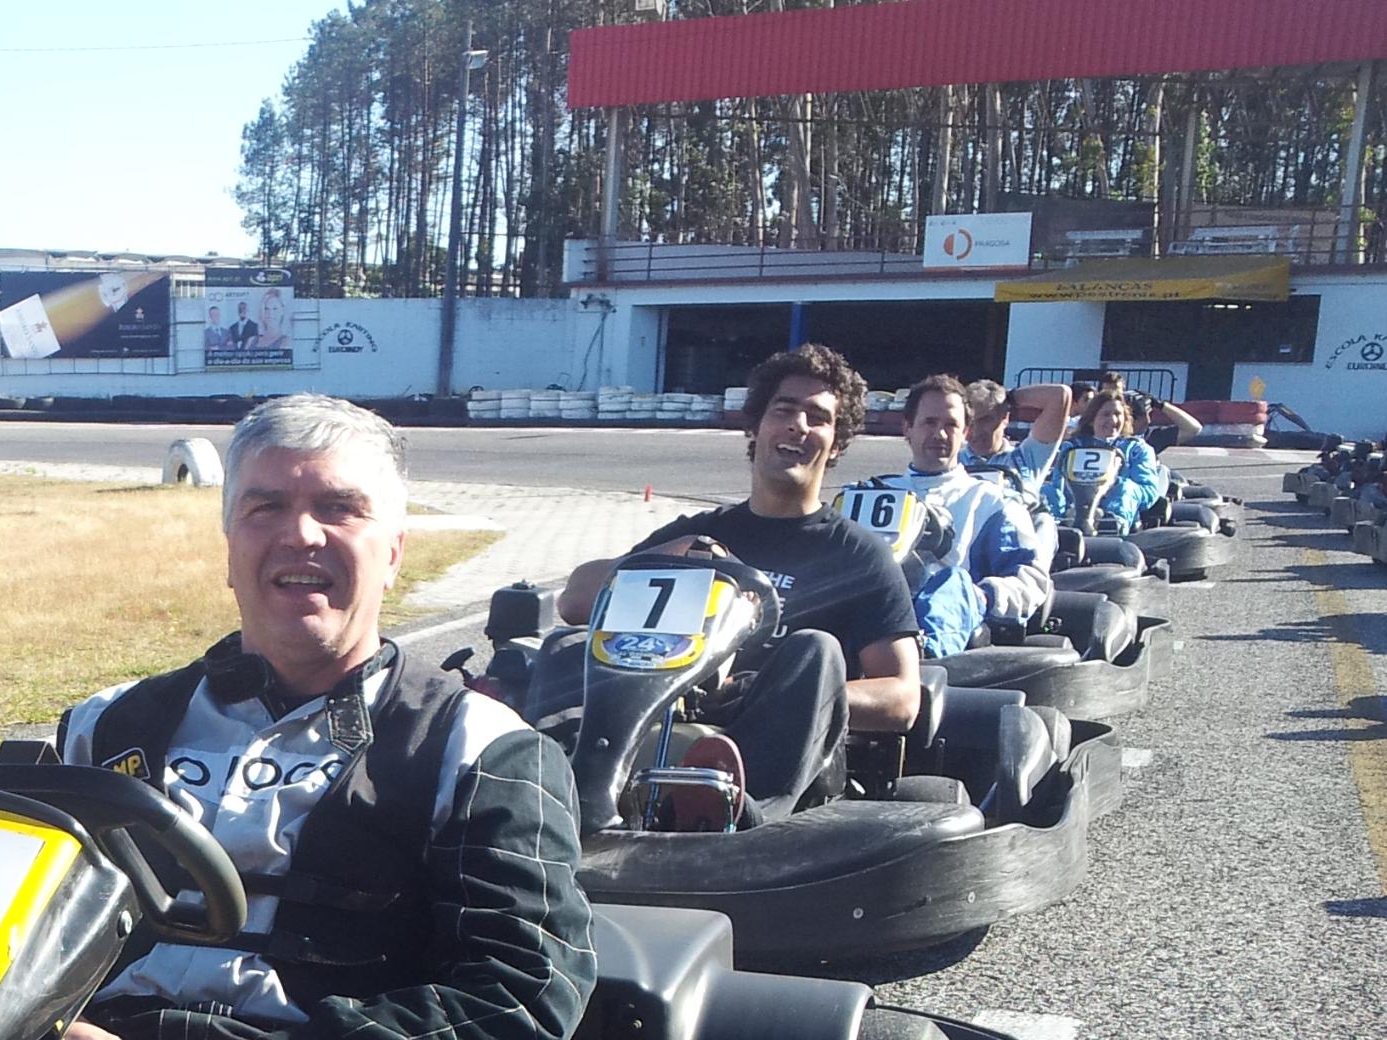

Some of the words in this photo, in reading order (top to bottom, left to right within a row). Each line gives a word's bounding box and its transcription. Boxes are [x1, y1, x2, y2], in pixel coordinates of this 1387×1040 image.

[1084, 451, 1101, 471] 2
[849, 492, 897, 528] 16
[642, 577, 677, 629] 7
[621, 636, 655, 650] 24
[113, 754, 142, 777] MP
